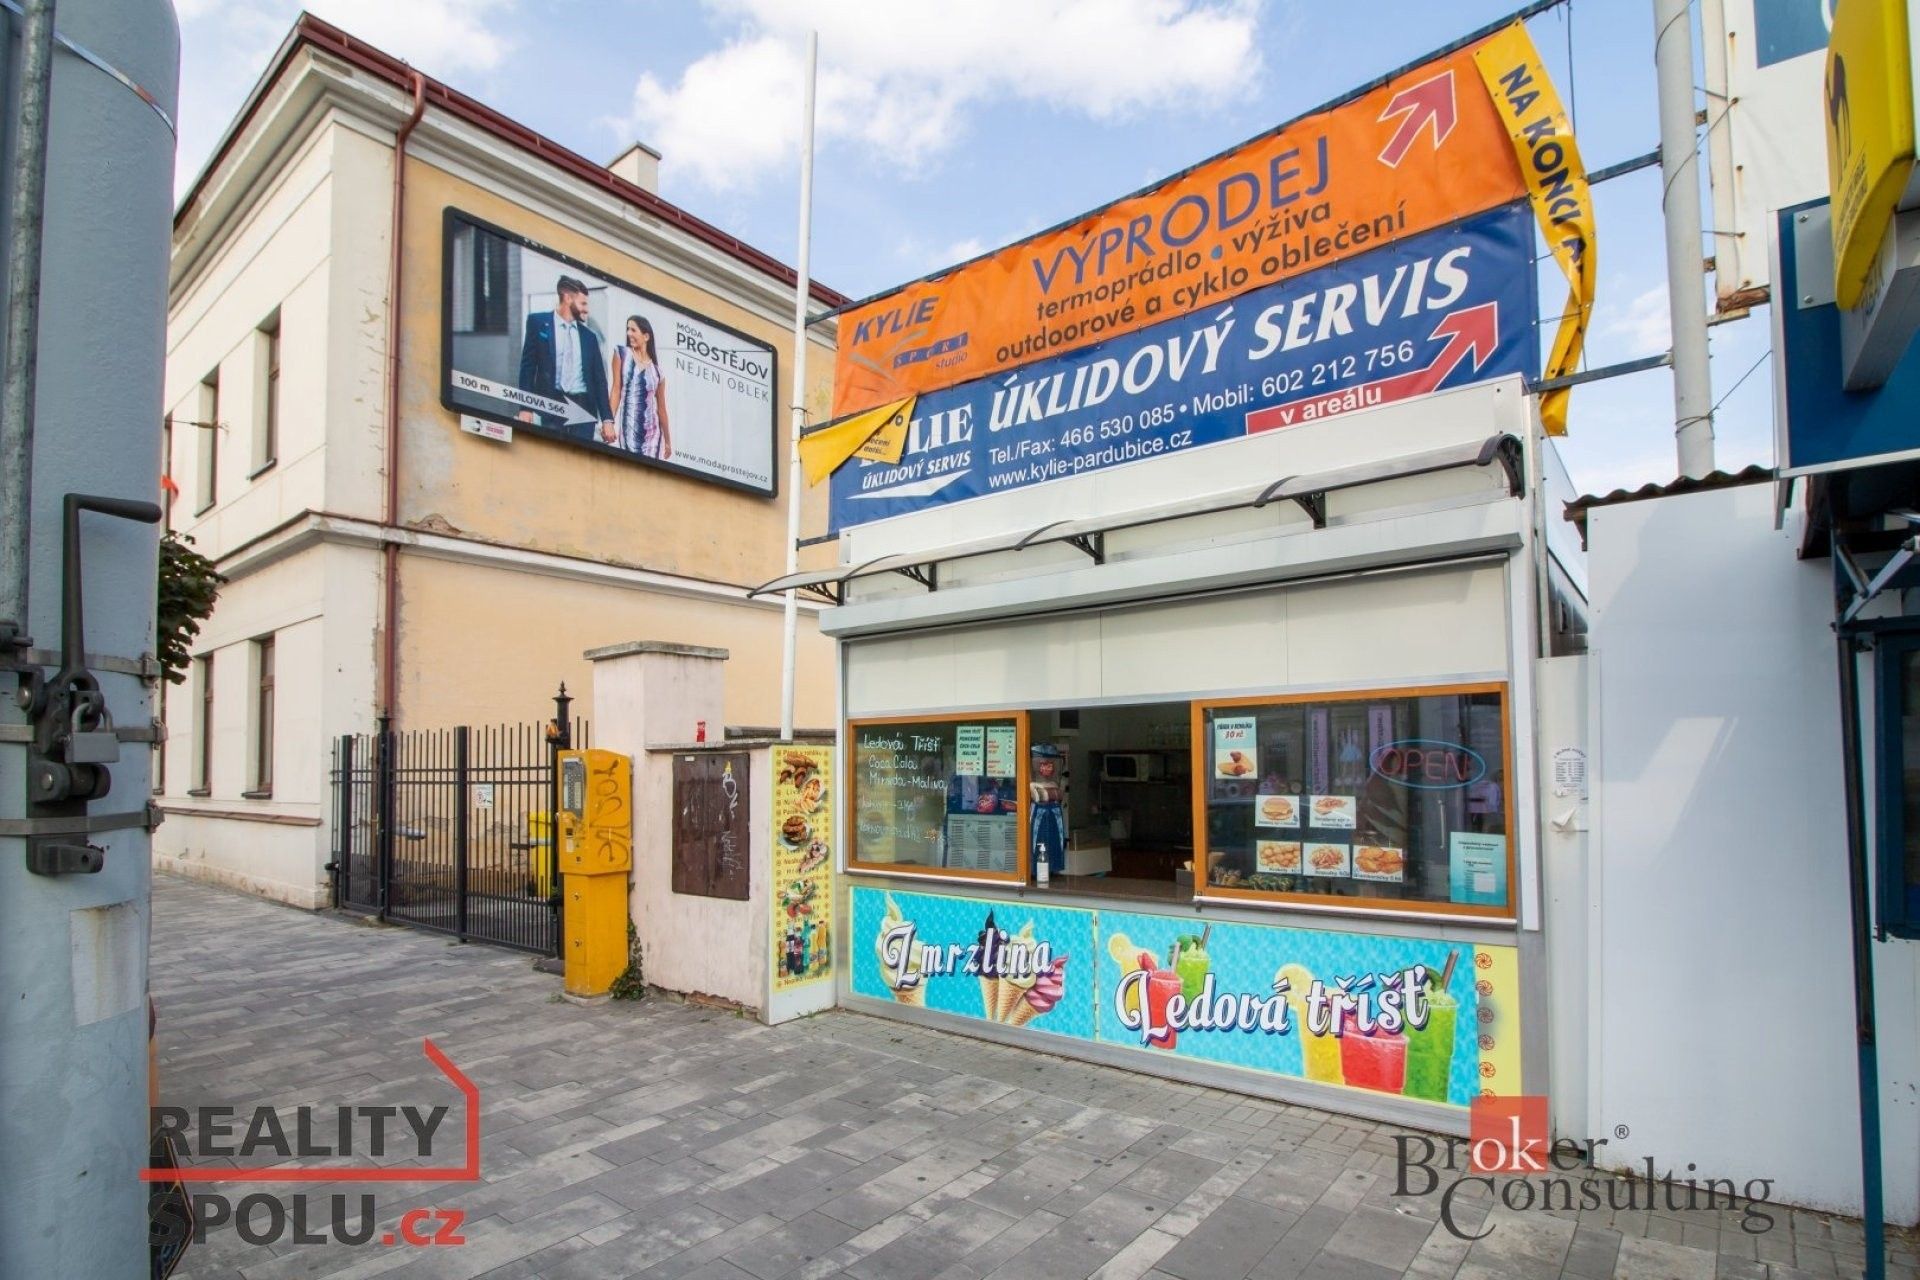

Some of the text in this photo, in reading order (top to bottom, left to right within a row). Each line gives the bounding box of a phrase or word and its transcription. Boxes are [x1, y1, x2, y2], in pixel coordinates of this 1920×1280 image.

[1499, 63, 1541, 117] NA
[1032, 136, 1329, 295] VÝPRODEJ
[996, 199, 1408, 364] outdoorové a cyklo oblečení
[1037, 202, 1331, 321] termoprádlo výživa
[676, 322, 704, 340] MODA
[852, 296, 940, 347] KYLIE
[988, 246, 1472, 433] ÚKLIDOVÝ SERVIS
[676, 332, 768, 380] PROSTĚJOV
[676, 357, 769, 402] NEJEN OBLEK
[935, 350, 968, 370] studio
[460, 376, 565, 415] 100 m SMILOVA 566
[989, 340, 1414, 465] Tel./Fax: 466 530 085 Mobil: 602 212 756
[1280, 385, 1382, 426] v areálu
[862, 450, 971, 490] ÚKLIDOVÝ SERVIS
[988, 430, 1193, 489] www.kylie-pardubice.cz
[1379, 747, 1469, 782] OPEN
[882, 919, 1054, 990] Zmrzlina
[1114, 964, 1431, 1048] Ledová tříšť
